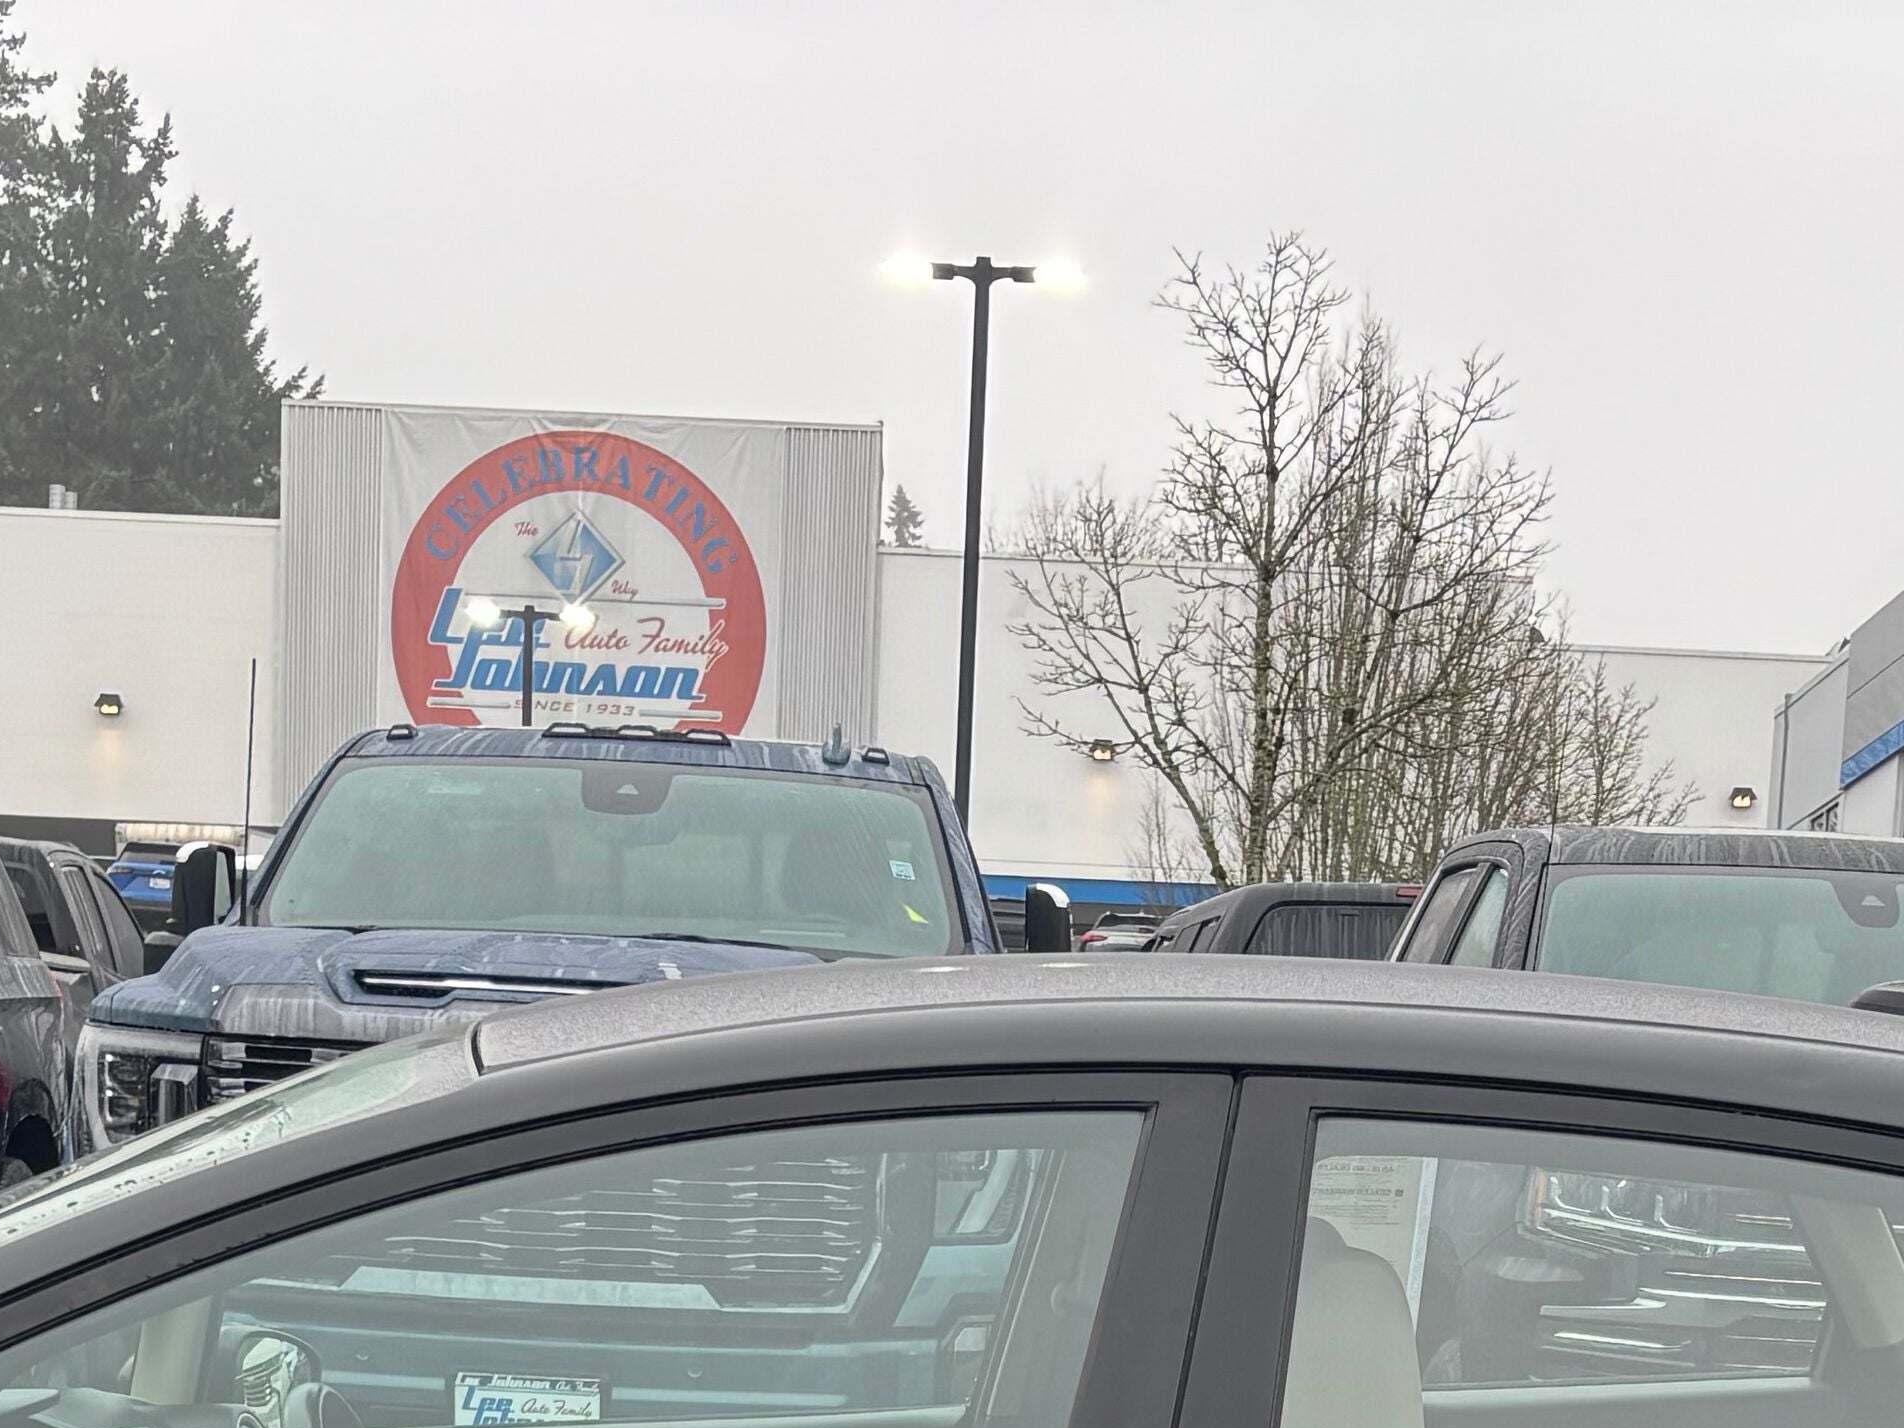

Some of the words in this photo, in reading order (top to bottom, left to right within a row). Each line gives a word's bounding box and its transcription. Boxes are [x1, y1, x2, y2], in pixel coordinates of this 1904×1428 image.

[425, 444, 738, 573] CELEBRATING
[514, 521, 539, 537] The
[610, 579, 638, 599] Way
[563, 614, 631, 651] Auto
[636, 616, 729, 672] Family
[513, 699, 575, 713] SNCE
[585, 702, 636, 717] 1933
[462, 1386, 515, 1414] Lee
[520, 1397, 551, 1415] Auto
[552, 1399, 593, 1419] Family
